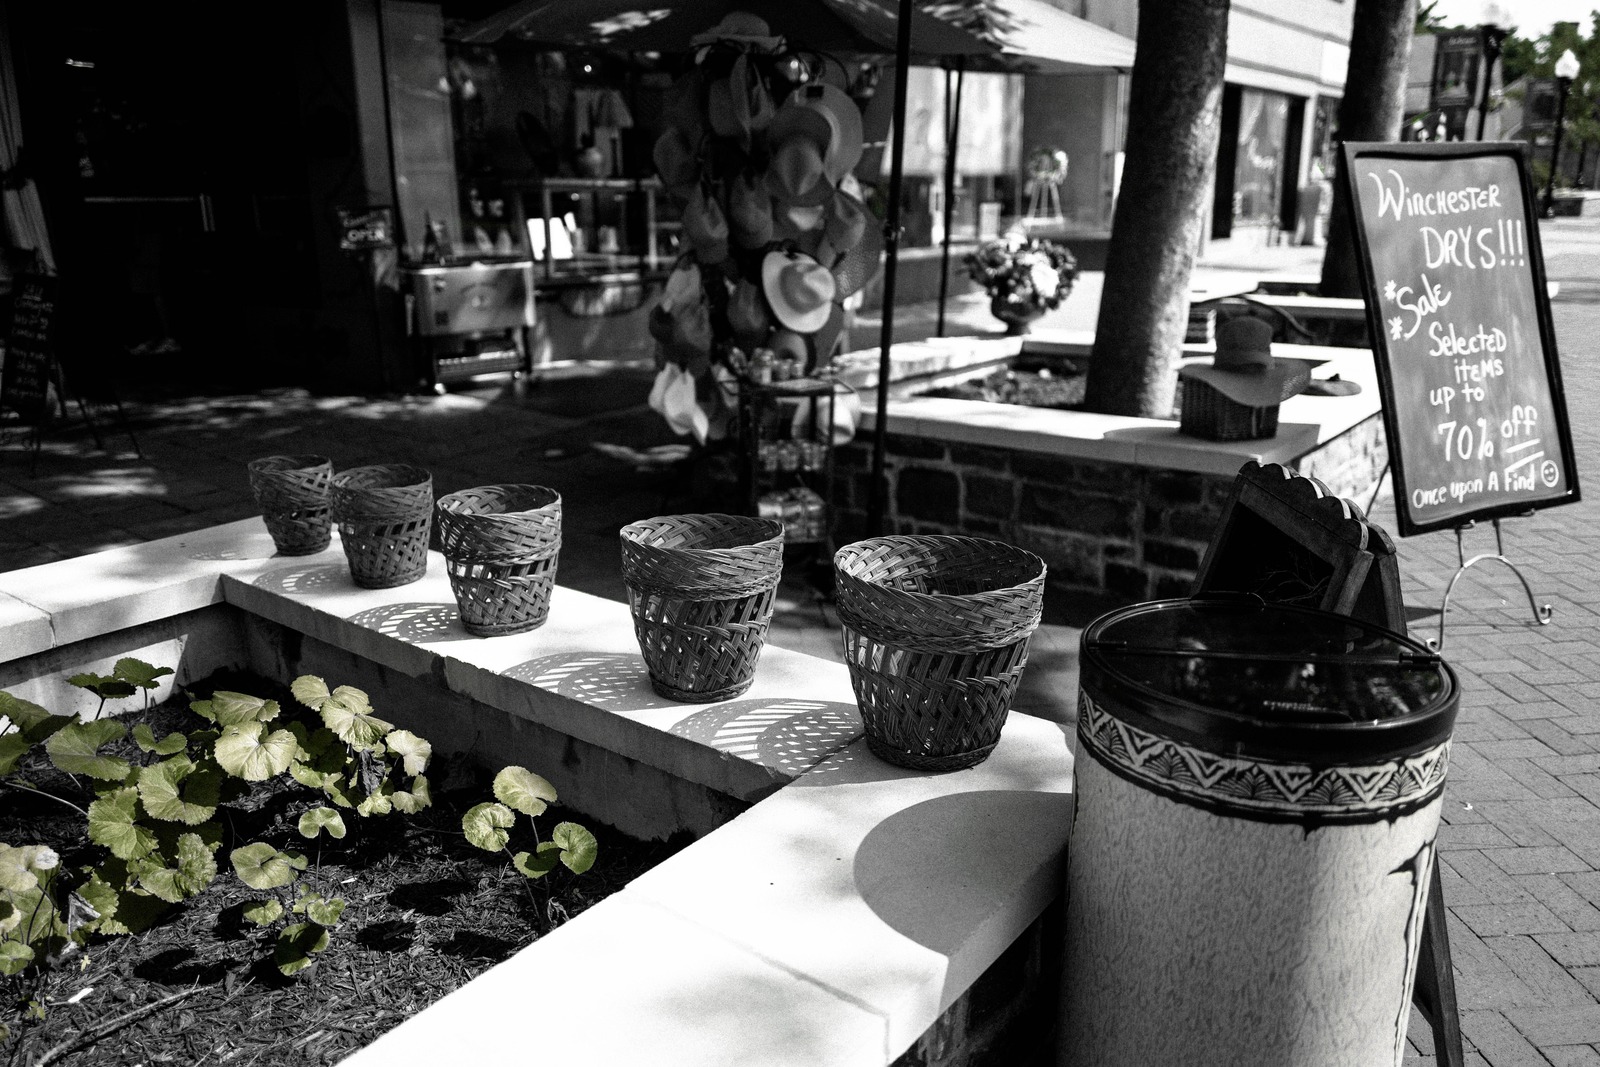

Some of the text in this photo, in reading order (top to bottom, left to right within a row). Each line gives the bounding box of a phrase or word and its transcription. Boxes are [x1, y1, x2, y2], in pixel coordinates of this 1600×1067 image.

[1430, 383, 1485, 414] up to
[1437, 404, 1538, 462] 70% off
[1412, 463, 1535, 509] Once upon A Find
